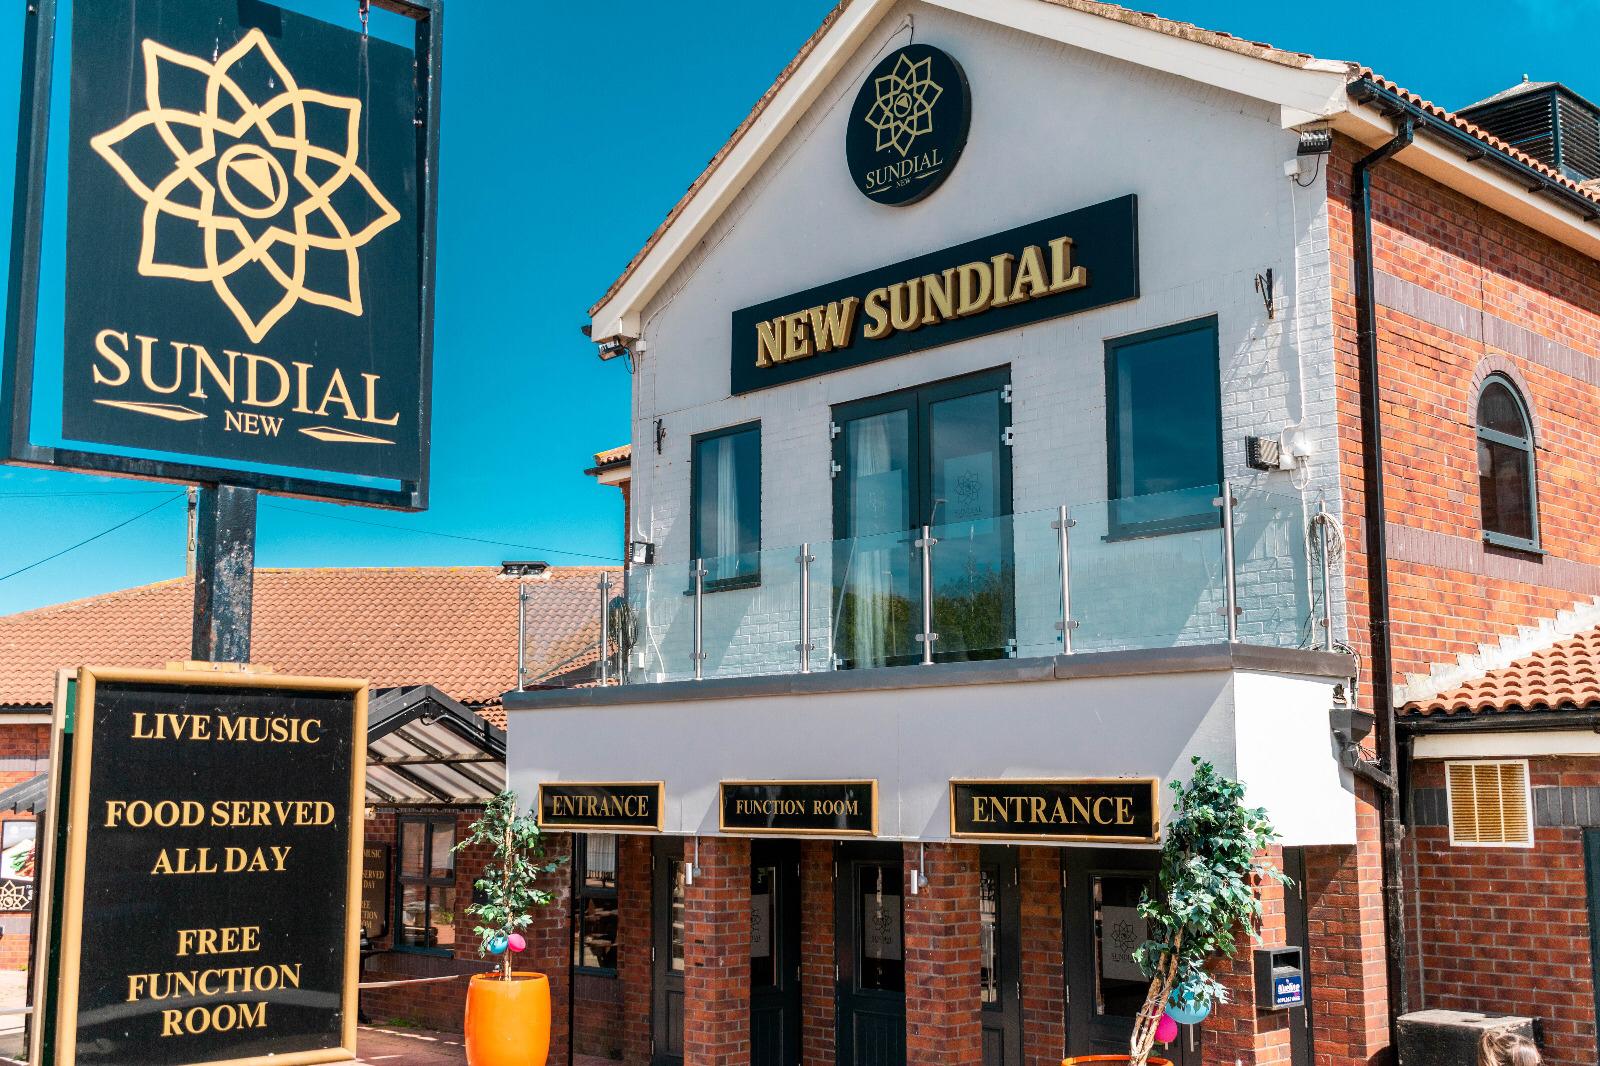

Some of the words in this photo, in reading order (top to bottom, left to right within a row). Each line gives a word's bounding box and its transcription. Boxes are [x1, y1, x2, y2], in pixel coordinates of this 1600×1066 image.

[866, 149, 944, 189] SUNDIAL
[896, 177, 912, 188] NEW
[755, 296, 859, 368] NEW
[863, 236, 1087, 339] SUNDIAL
[92, 328, 400, 426] SUNDIAL
[223, 410, 284, 437] NEW
[131, 712, 211, 740] LIVE
[216, 715, 322, 744] MUSIC
[104, 800, 205, 827] FOOD
[211, 801, 335, 827] SERVED
[551, 794, 650, 818] ENTRANCE
[735, 800, 806, 816] FUNCTION
[813, 800, 859, 816] ROOM
[971, 796, 1136, 825] ENTRANCE
[151, 847, 218, 875] ALL
[223, 846, 292, 873] DAY
[176, 925, 261, 957] FREE
[126, 963, 302, 1002] FUNCTION
[160, 1001, 268, 1037] ROOM
